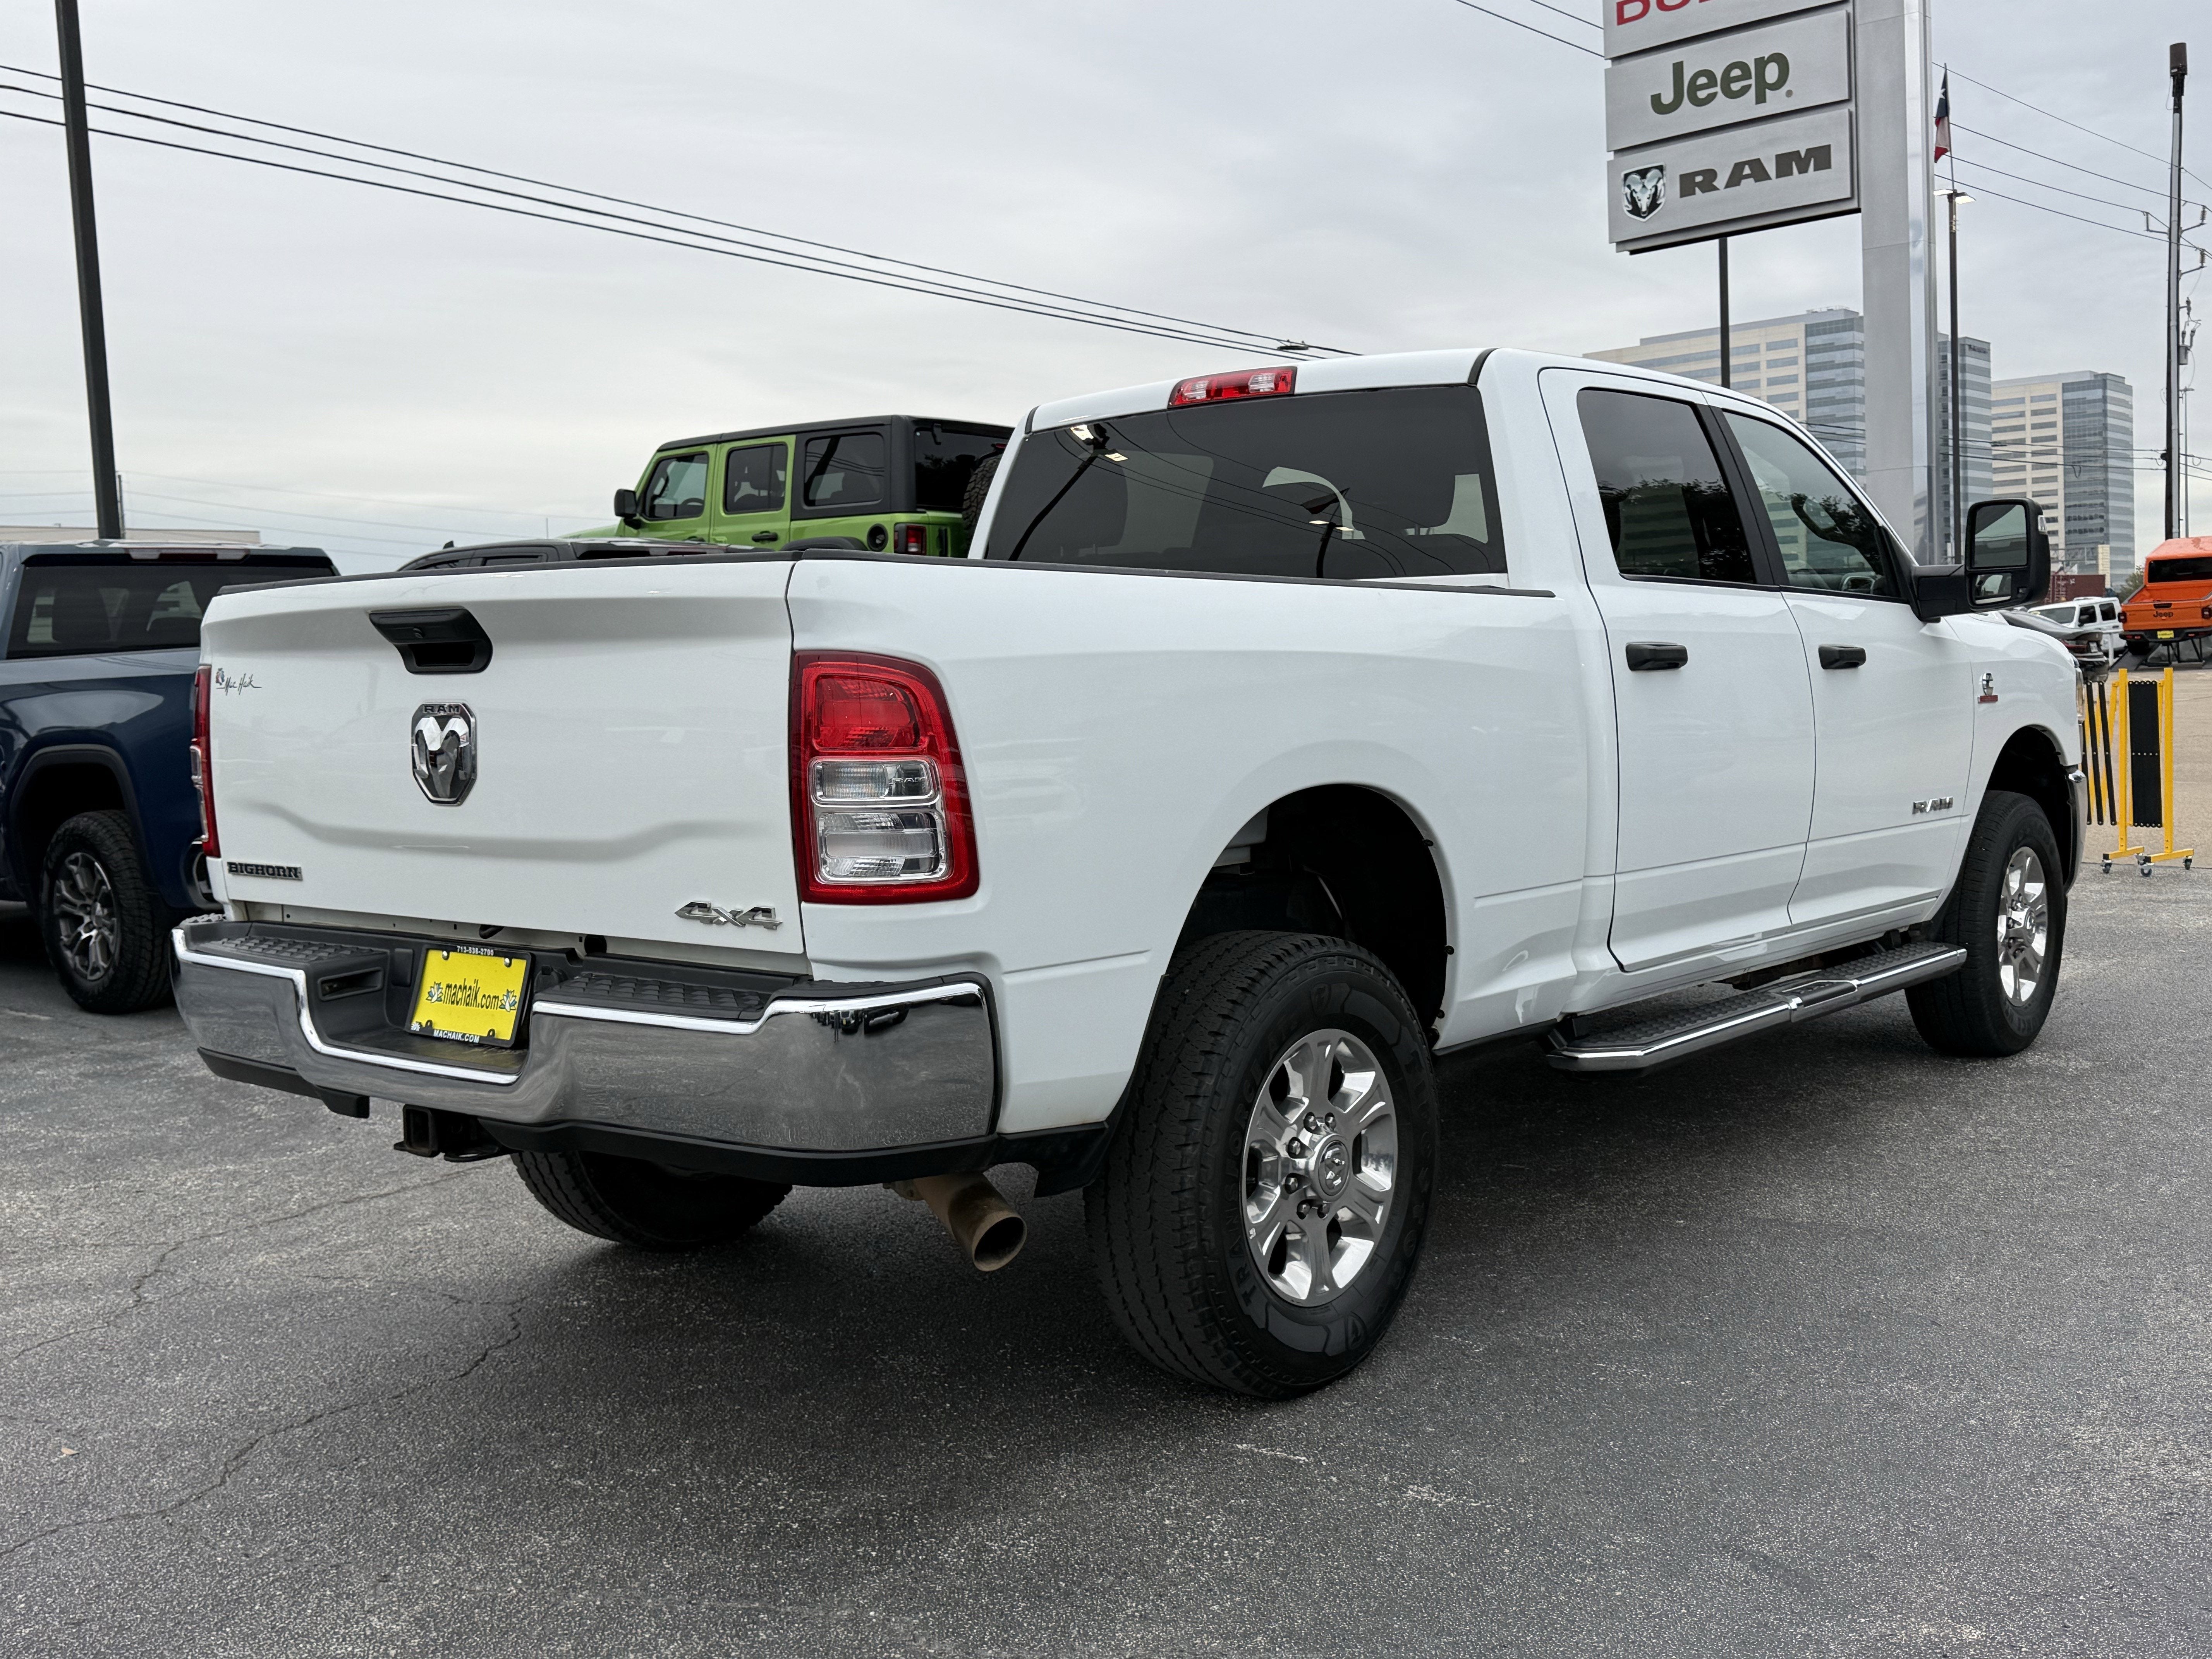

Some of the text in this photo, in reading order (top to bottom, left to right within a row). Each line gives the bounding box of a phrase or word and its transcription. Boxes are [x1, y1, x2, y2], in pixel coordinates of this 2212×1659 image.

[1650, 52, 1790, 115] Jeep
[1679, 144, 1832, 198] RAM
[424, 705, 460, 713] RAM
[1912, 797, 1953, 814] RAM
[227, 862, 299, 878] BIGHORN
[443, 978, 499, 1010] machaik.com
[433, 1030, 480, 1043] MACHAIK.COM
